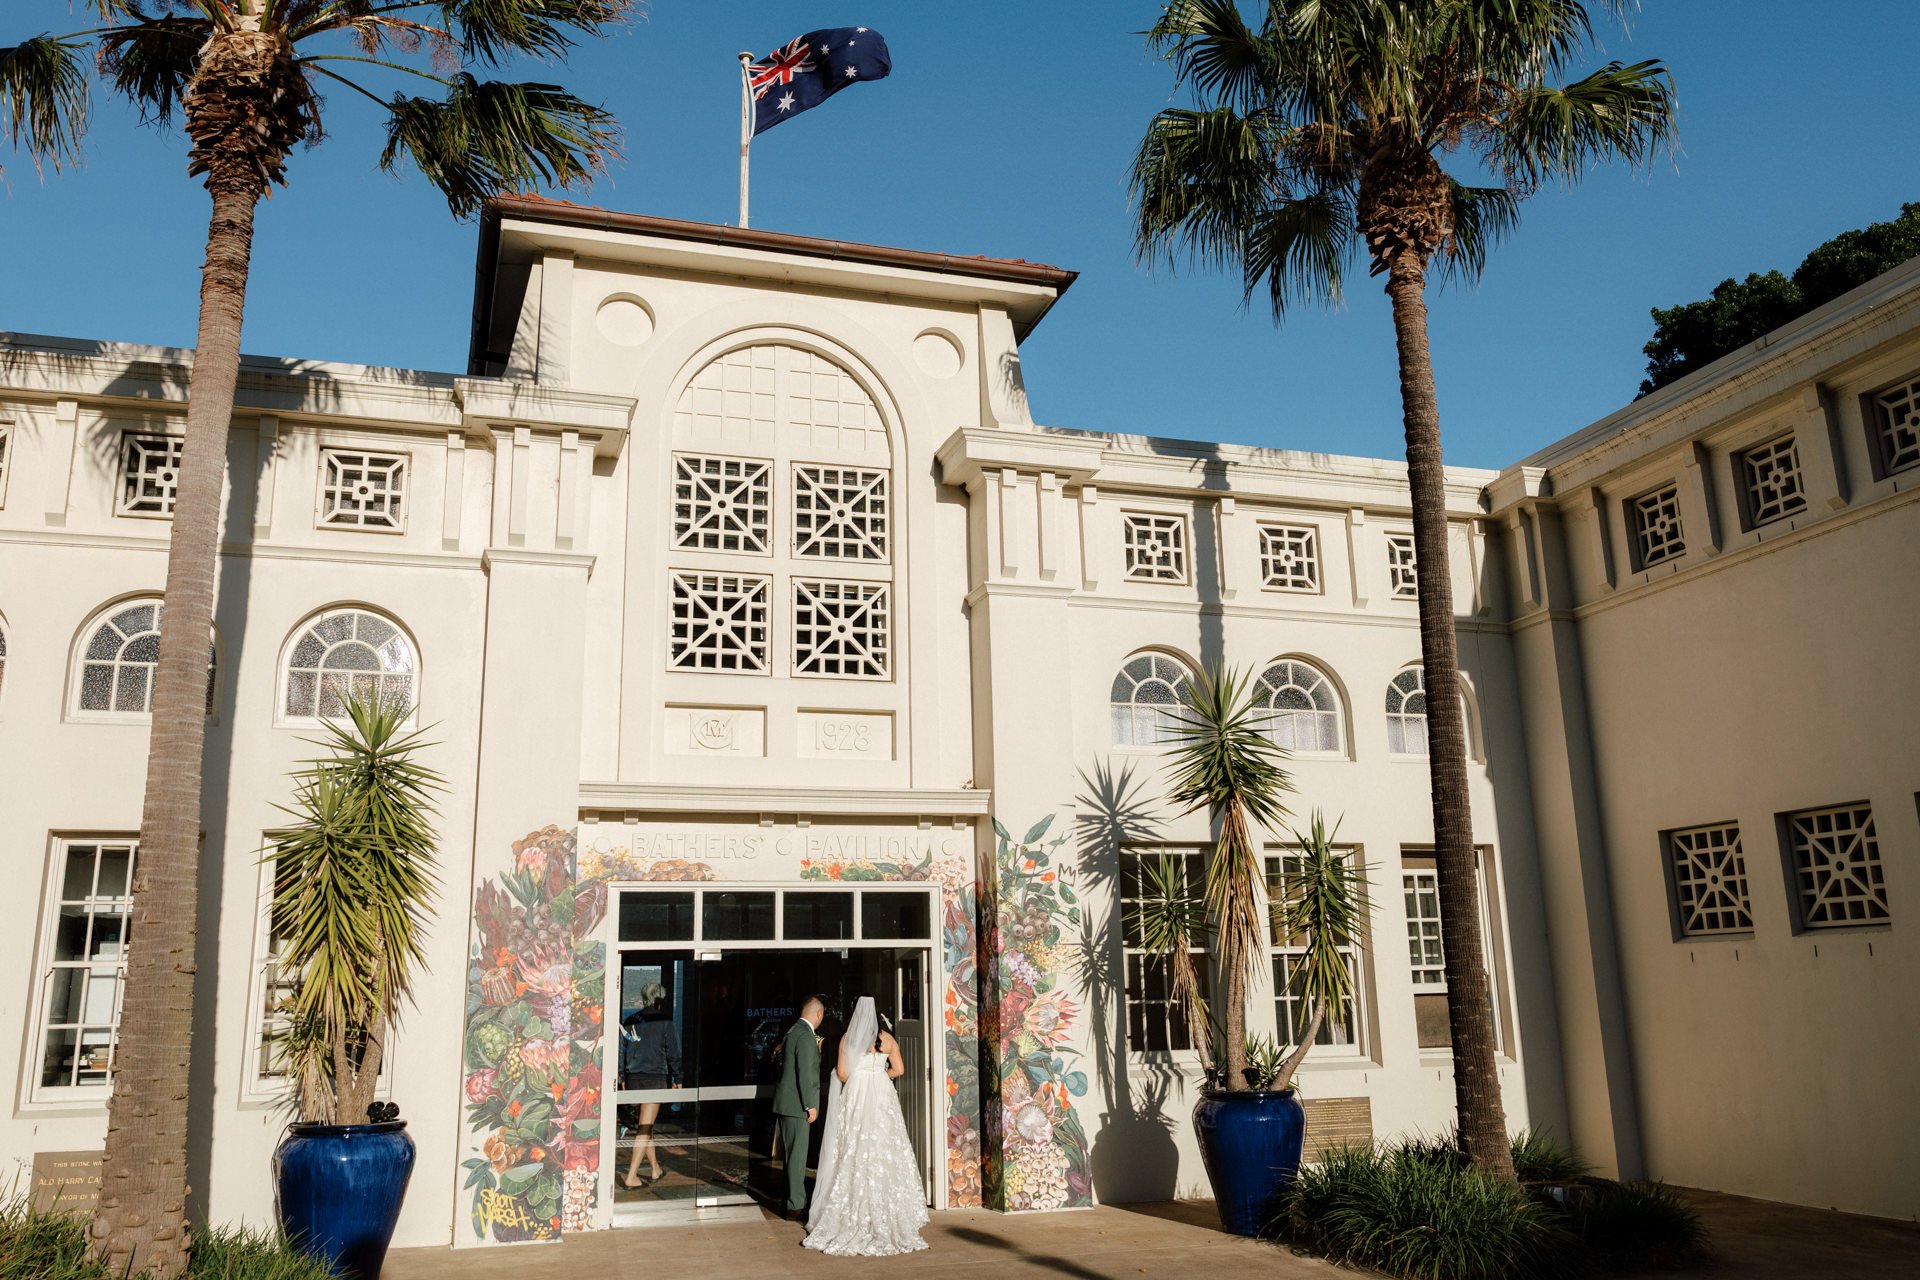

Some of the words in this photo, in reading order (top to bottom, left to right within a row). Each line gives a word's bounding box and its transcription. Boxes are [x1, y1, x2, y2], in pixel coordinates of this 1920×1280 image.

[815, 719, 872, 751] 1928
[804, 834, 923, 861] PAVILION
[57, 1176, 85, 1185] HARRY
[87, 1175, 102, 1184] CA
